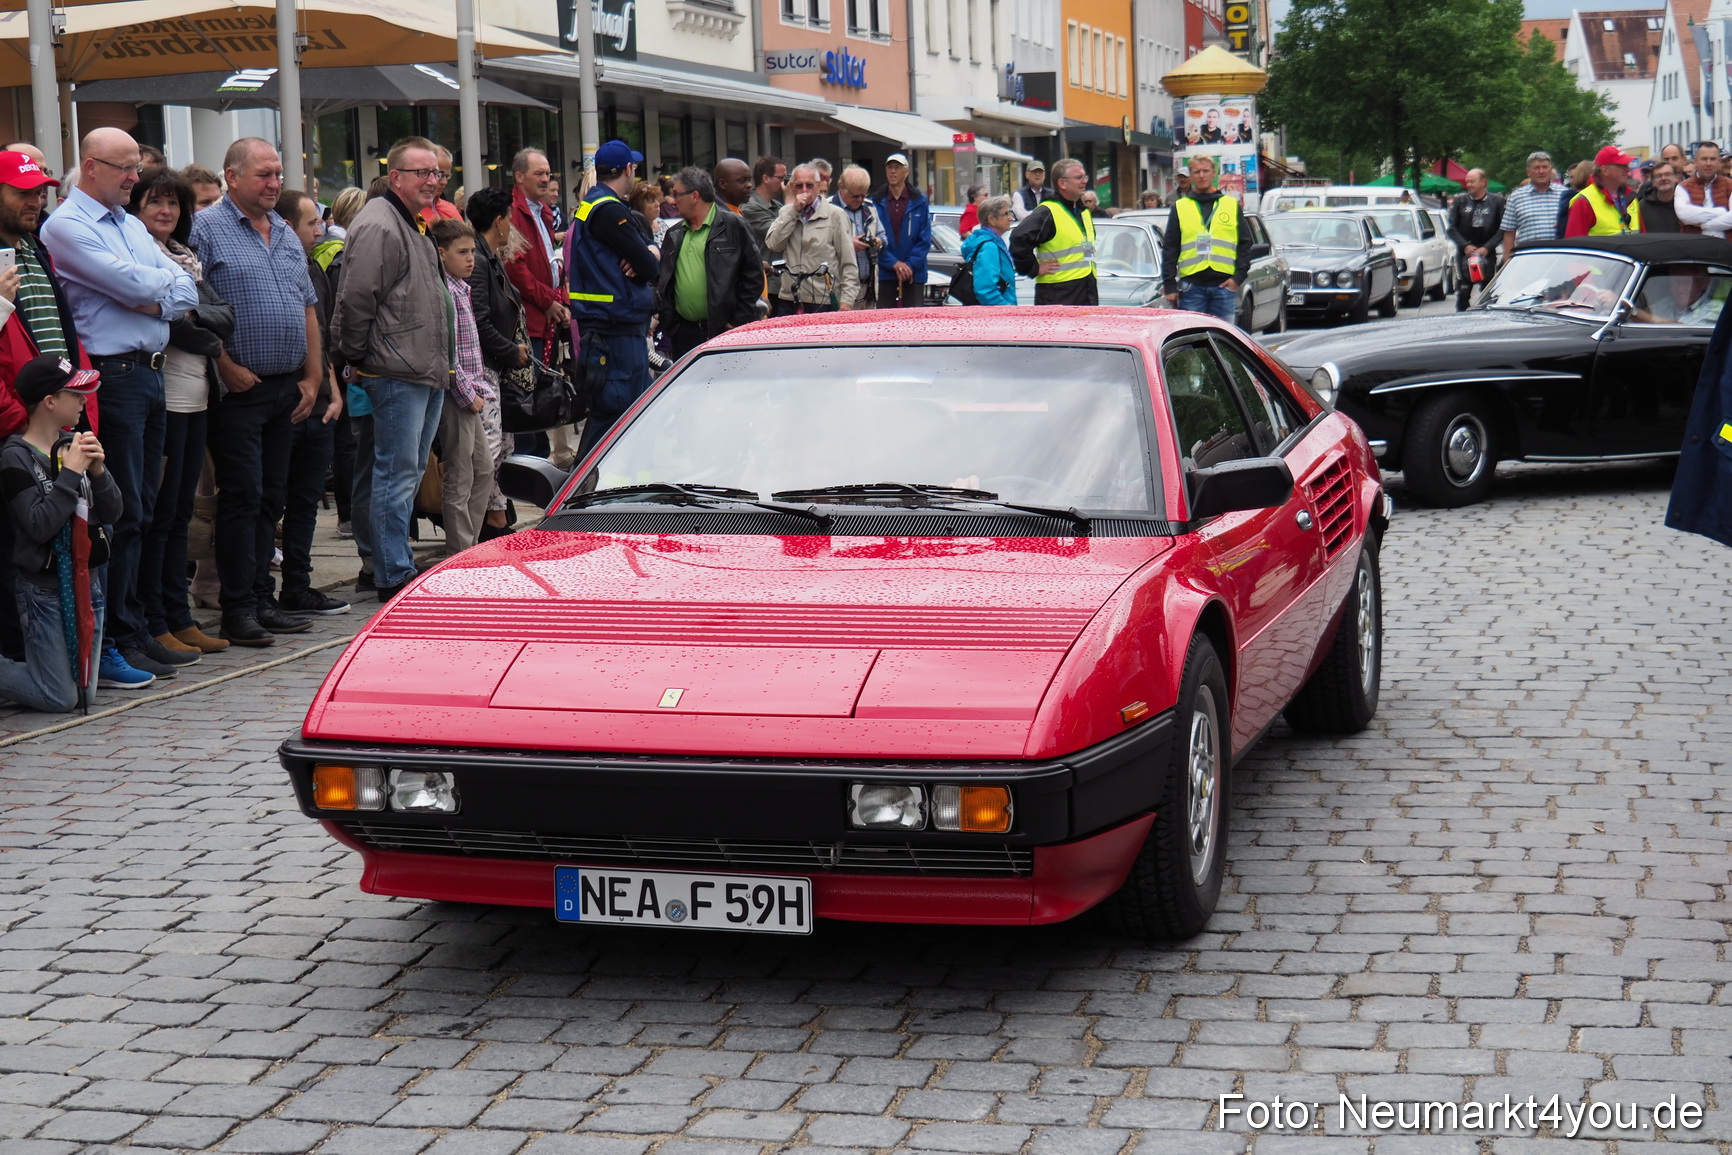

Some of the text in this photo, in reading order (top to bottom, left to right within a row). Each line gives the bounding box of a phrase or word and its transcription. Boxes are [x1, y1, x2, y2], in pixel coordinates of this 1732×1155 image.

[766, 53, 817, 70] sutor.
[823, 46, 868, 89] sutor.
[564, 899, 573, 911] D
[581, 875, 804, 926] NEA F 59H
